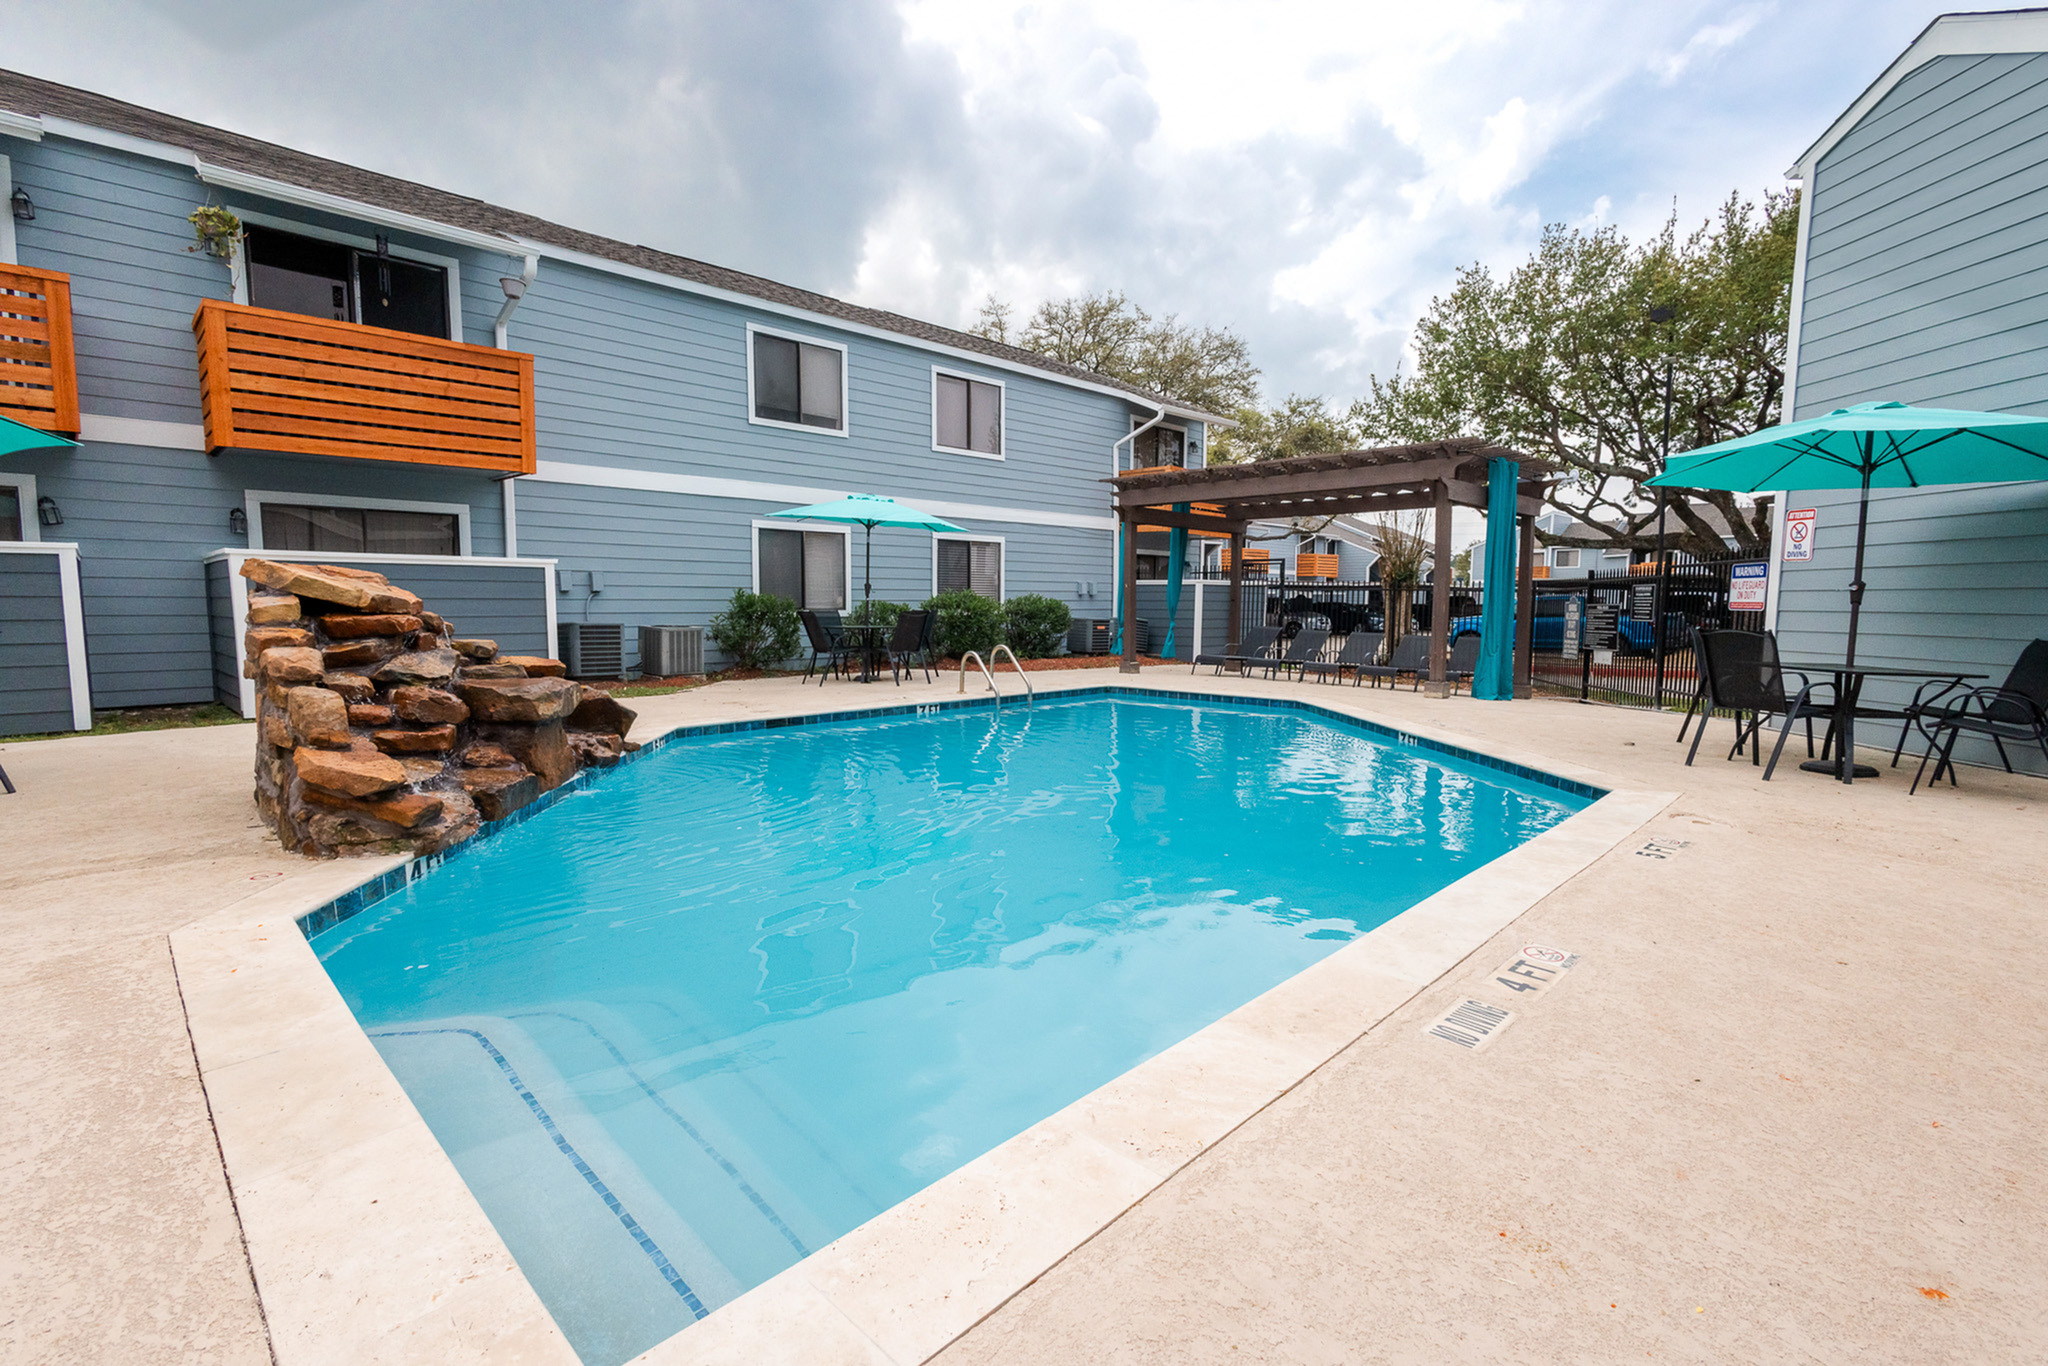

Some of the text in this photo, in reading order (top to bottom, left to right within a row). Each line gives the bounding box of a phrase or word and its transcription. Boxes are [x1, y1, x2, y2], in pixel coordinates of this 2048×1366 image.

[1787, 550, 1807, 558] DIVING
[1735, 565, 1765, 577] WARNING
[1739, 580, 1765, 590] LIFEGUARD
[1744, 590, 1757, 600] DUTY
[1643, 843, 1677, 855] FT
[1635, 851, 1667, 860] 5
[411, 859, 424, 881] 4
[1507, 959, 1557, 982] FT
[1495, 976, 1539, 992] 4
[1428, 999, 1510, 1049] NO DIVING
